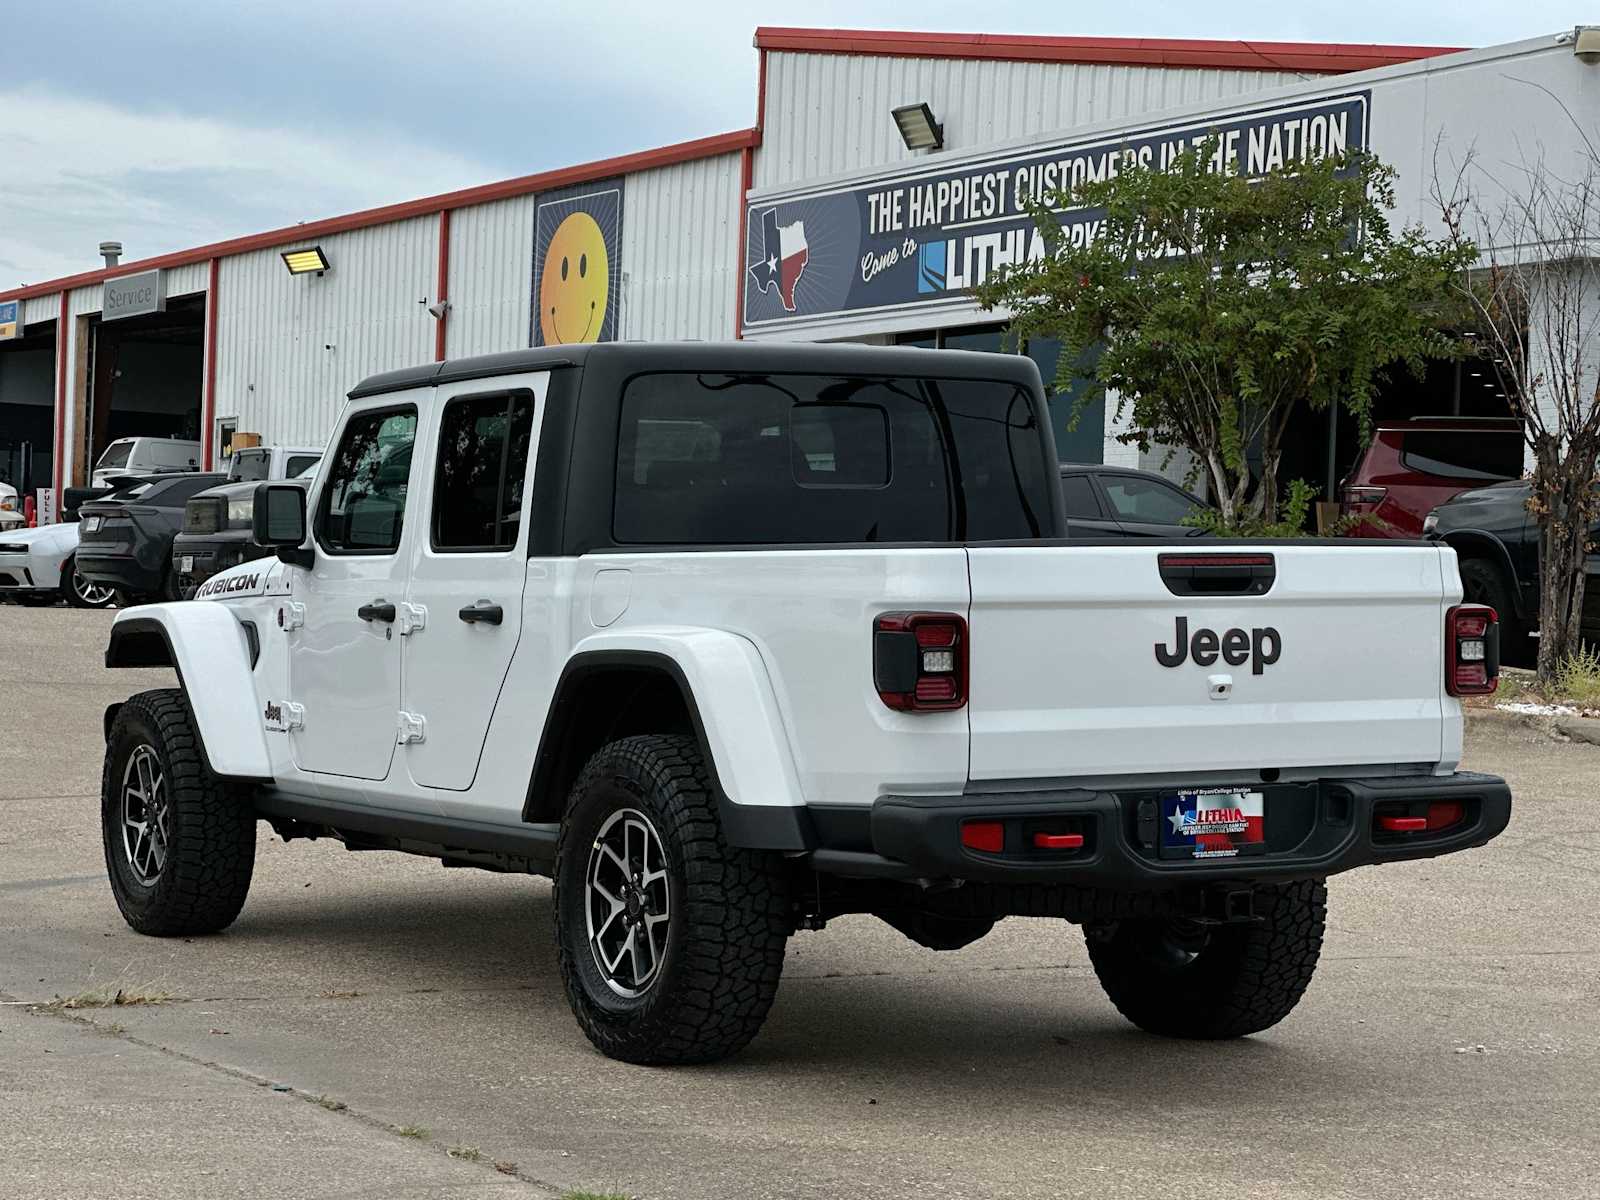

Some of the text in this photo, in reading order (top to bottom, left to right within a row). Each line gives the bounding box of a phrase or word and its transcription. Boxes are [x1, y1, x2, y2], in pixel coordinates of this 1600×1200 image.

[868, 190, 904, 234] THE
[909, 171, 1009, 228] HAPPIEST
[1160, 139, 1185, 176] IN
[1247, 111, 1348, 175] NATION
[861, 237, 917, 283] Come to
[946, 226, 1047, 290] LITHIA
[108, 287, 151, 309] Service
[197, 573, 260, 599] RUBICON
[1155, 616, 1282, 675] Jeep
[264, 700, 281, 725] Jeep
[1197, 807, 1246, 824] LITHIA
